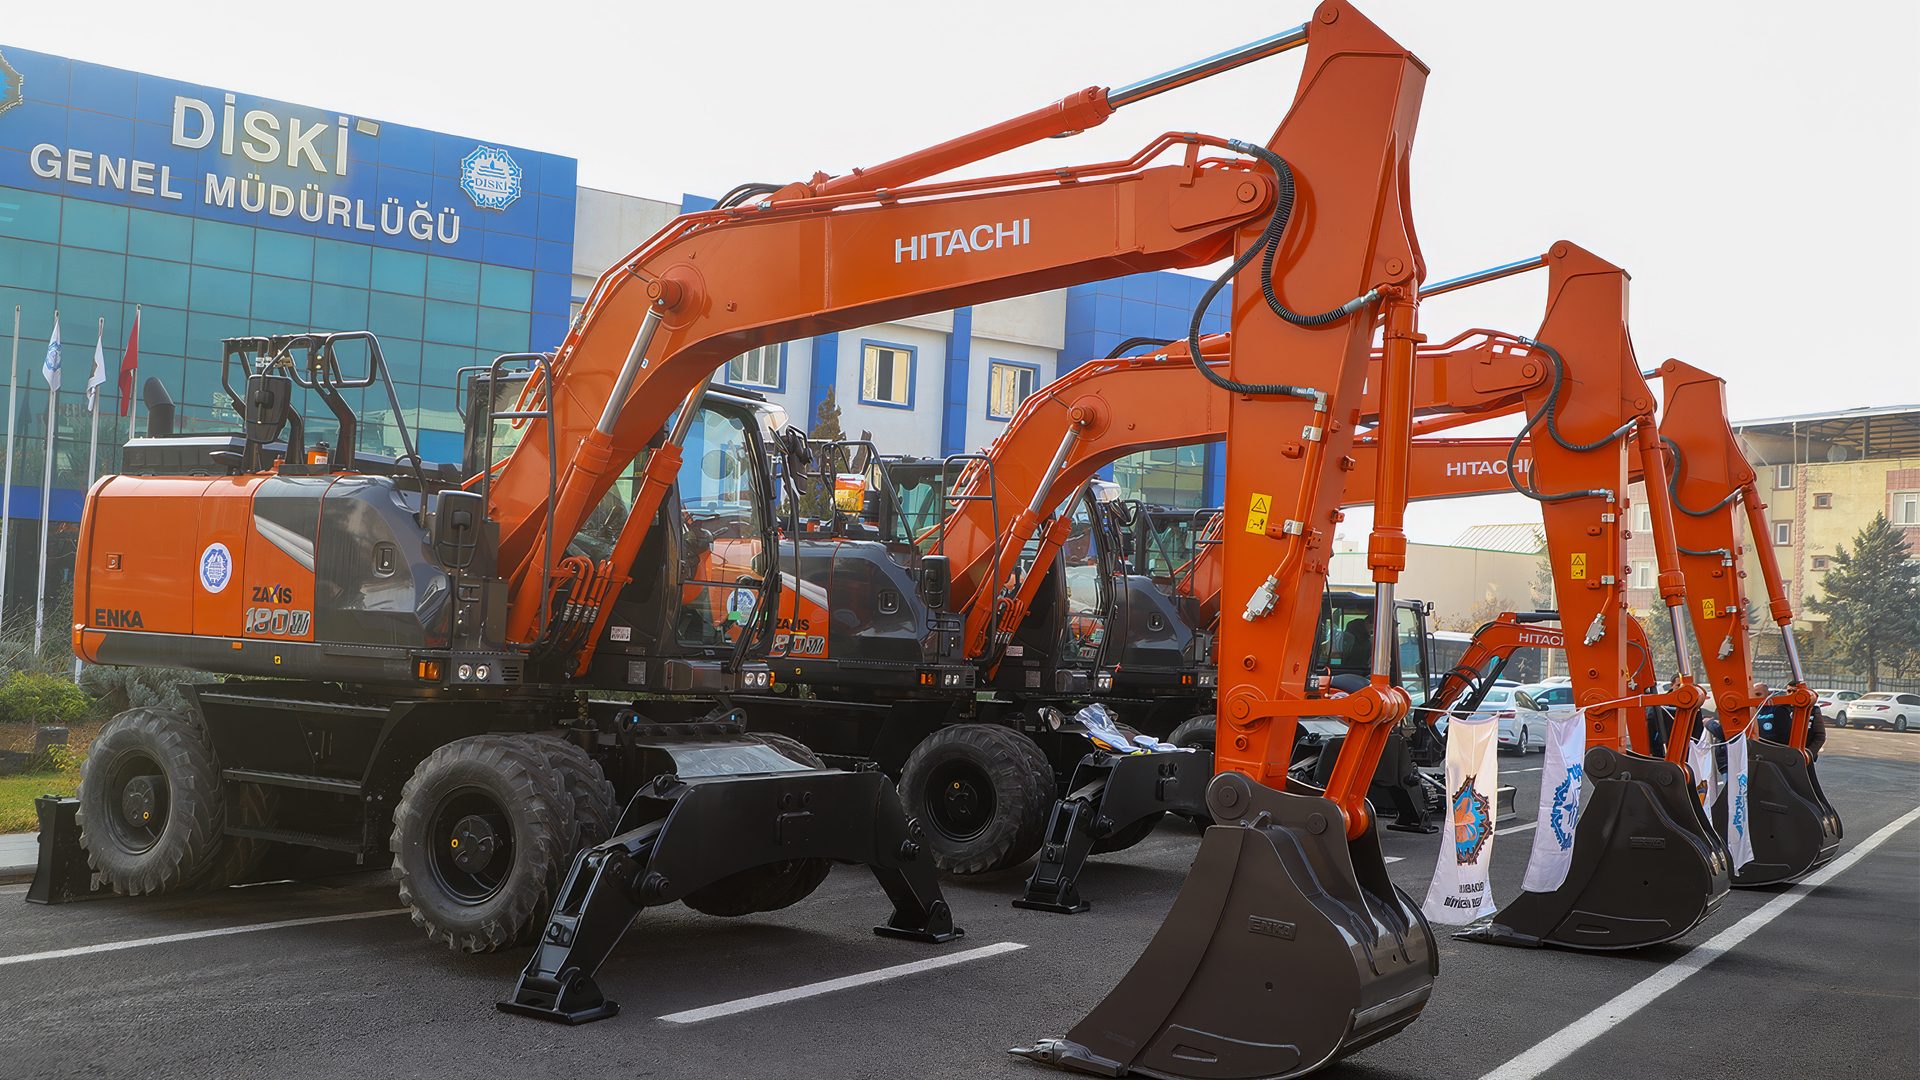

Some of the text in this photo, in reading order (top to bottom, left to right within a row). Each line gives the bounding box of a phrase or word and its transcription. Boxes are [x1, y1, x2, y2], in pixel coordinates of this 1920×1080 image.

[172, 93, 349, 176] DİSKİ
[30, 143, 460, 244] GENEL MÜDÜRLÜĞÜ
[895, 218, 1030, 264] HITACHI
[252, 584, 293, 604] ZAXIS
[95, 608, 144, 628] ENKA
[245, 607, 312, 637] 180W
